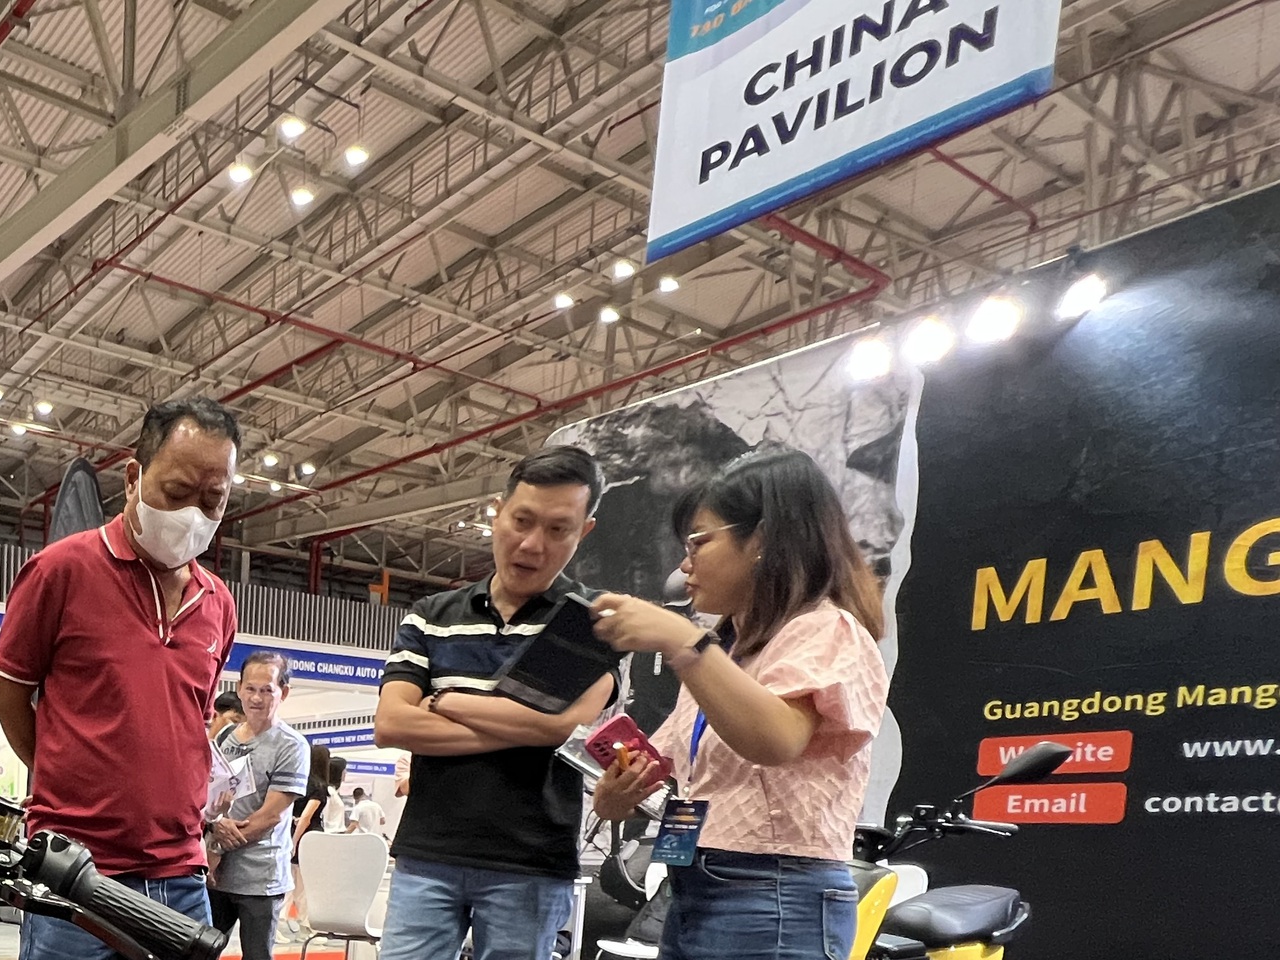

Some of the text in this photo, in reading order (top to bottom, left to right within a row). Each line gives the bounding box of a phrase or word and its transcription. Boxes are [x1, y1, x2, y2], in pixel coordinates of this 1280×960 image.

[743, 0, 949, 106] CHINA
[698, 5, 999, 185] PAVILION
[317, 663, 355, 677] CHANGXU
[355, 667, 377, 678] AUTO
[983, 684, 1280, 721] Guangdong Mang
[999, 739, 1280, 765] Wite www.
[1007, 791, 1280, 813] Email contact
